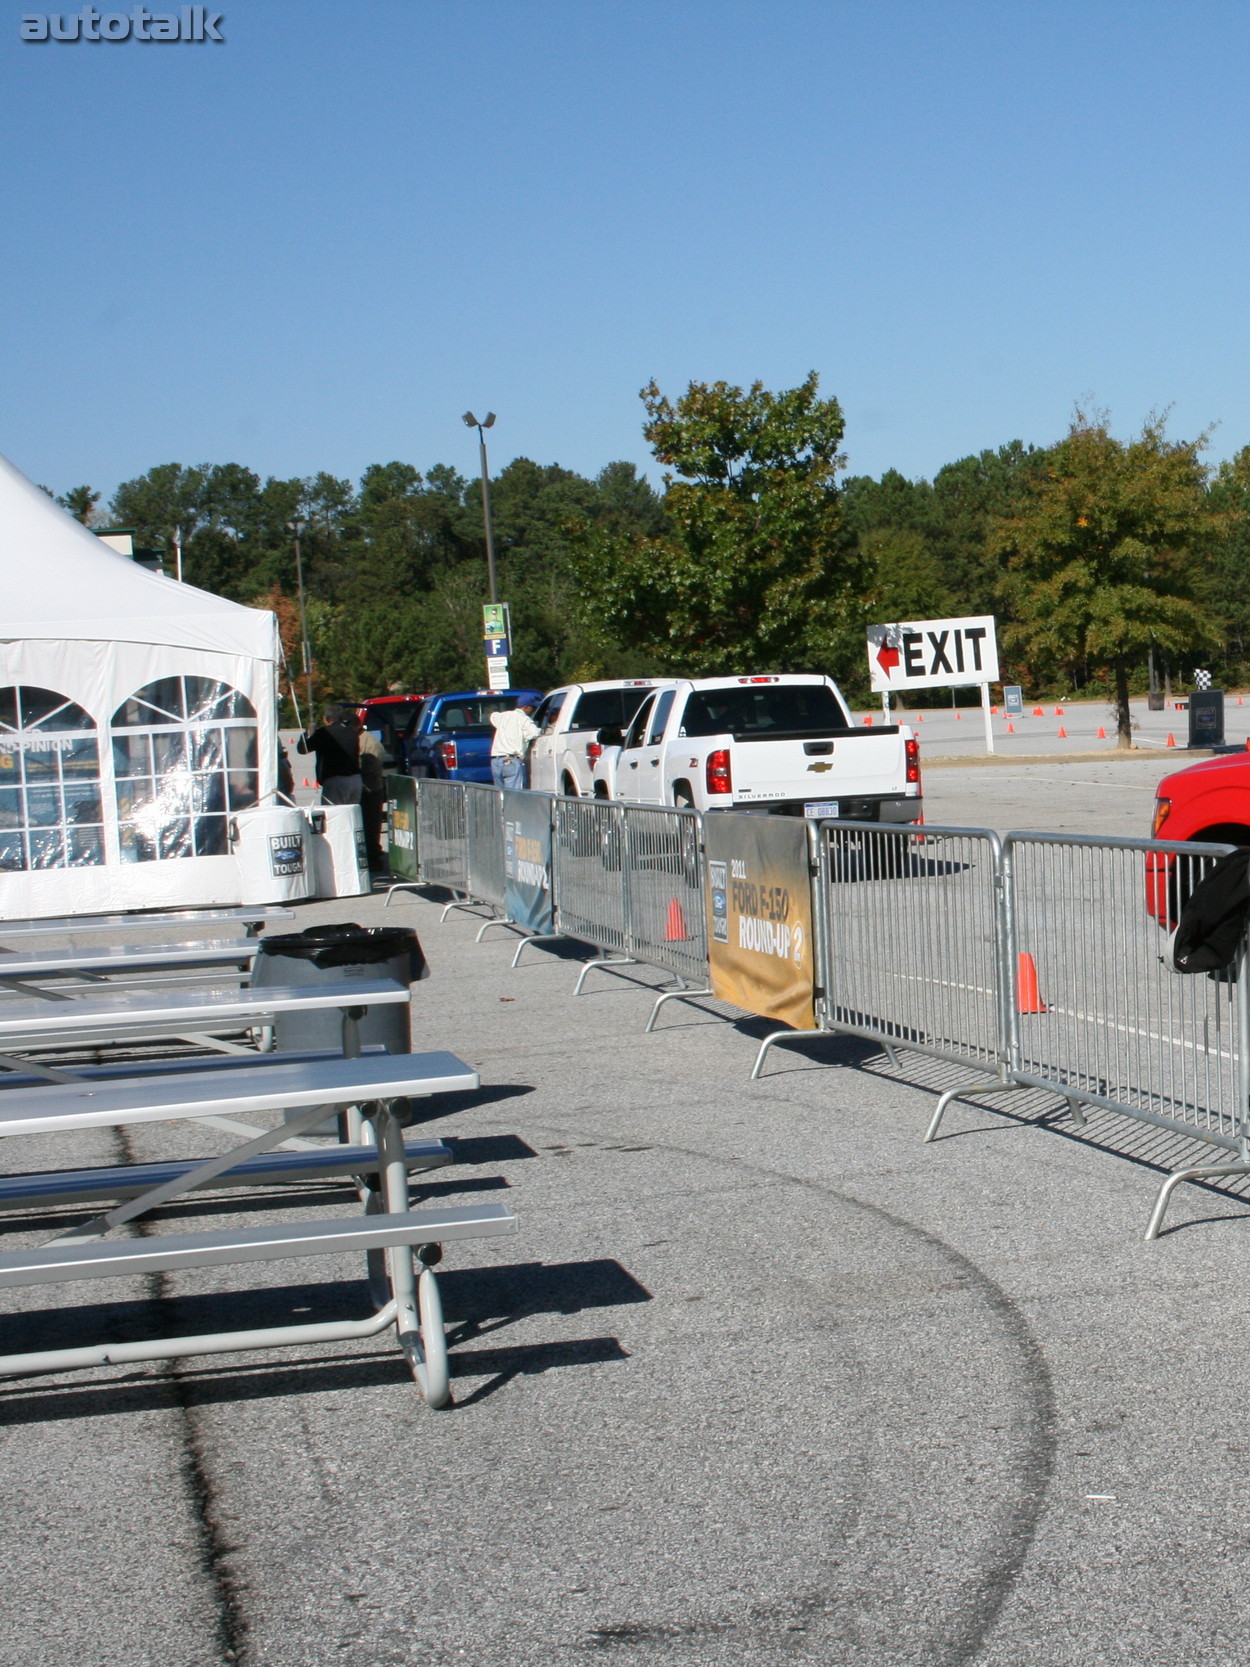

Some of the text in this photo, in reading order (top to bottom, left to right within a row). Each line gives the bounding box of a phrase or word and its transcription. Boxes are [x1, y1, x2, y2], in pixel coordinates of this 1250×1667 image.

[491, 639, 501, 655] F
[903, 627, 987, 677] EXIT
[738, 792, 786, 800] SILVERADO
[271, 835, 302, 850] BUILT
[732, 881, 758, 916] FORD
[760, 885, 789, 922] F-150
[738, 915, 804, 962] ROUND-UP 2
